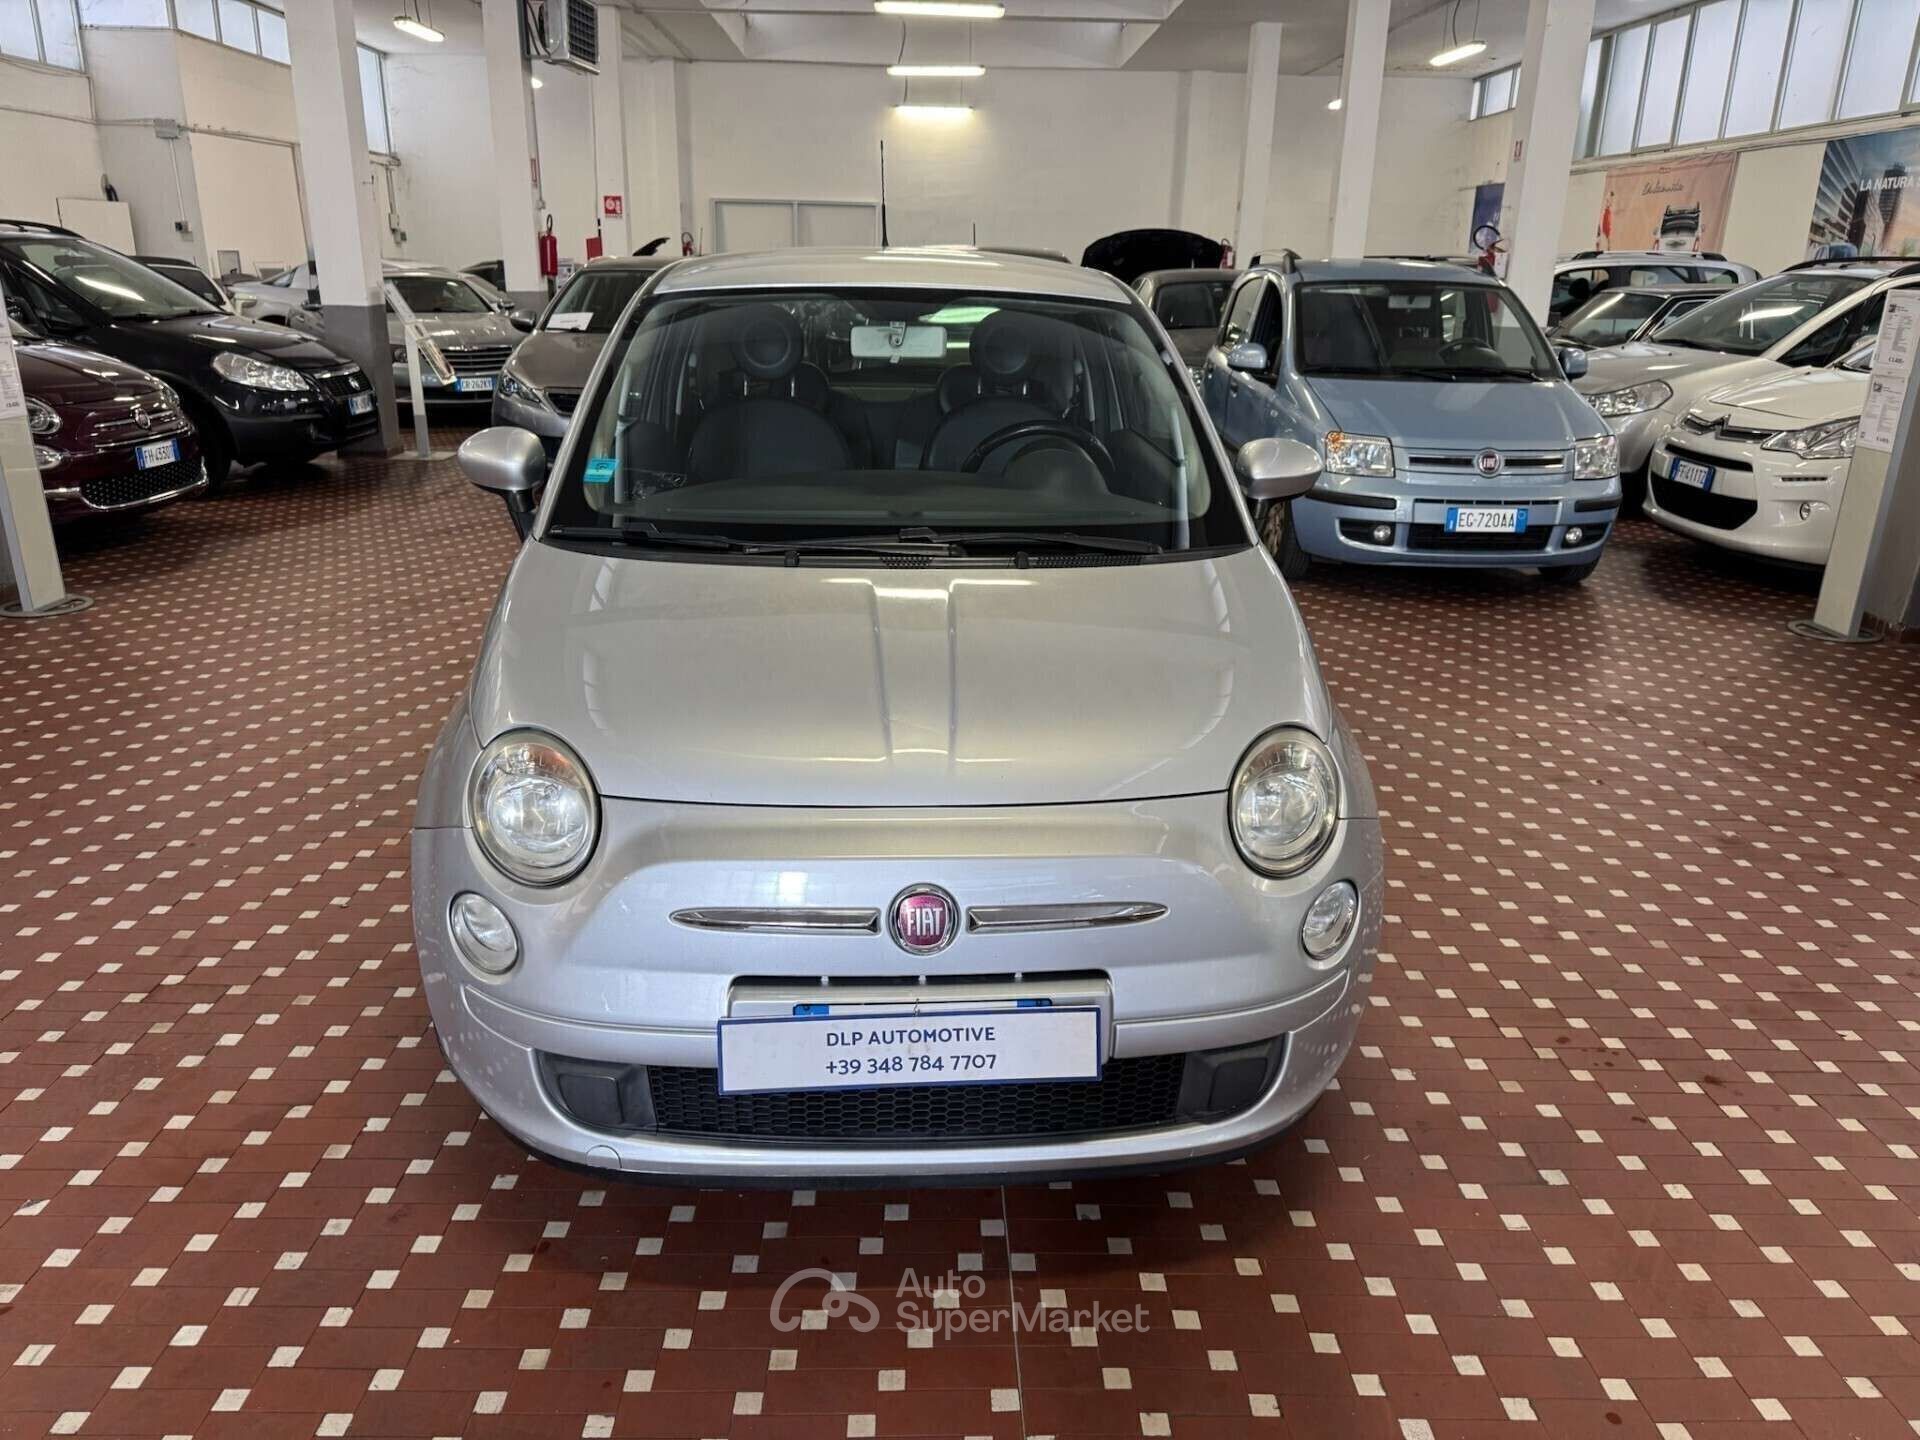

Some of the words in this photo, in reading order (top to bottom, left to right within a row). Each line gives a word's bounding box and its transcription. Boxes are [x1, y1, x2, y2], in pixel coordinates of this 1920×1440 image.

[1860, 178, 1872, 192] LA
[1873, 175, 1914, 190] NATURA
[906, 907, 943, 937] FIAT
[826, 1030, 863, 1047] DLP
[868, 1026, 996, 1045] AUTOMOTIVE
[826, 1059, 861, 1075] +39
[867, 1056, 903, 1074] 348
[908, 1054, 944, 1072] 784
[950, 1053, 997, 1071] 7707
